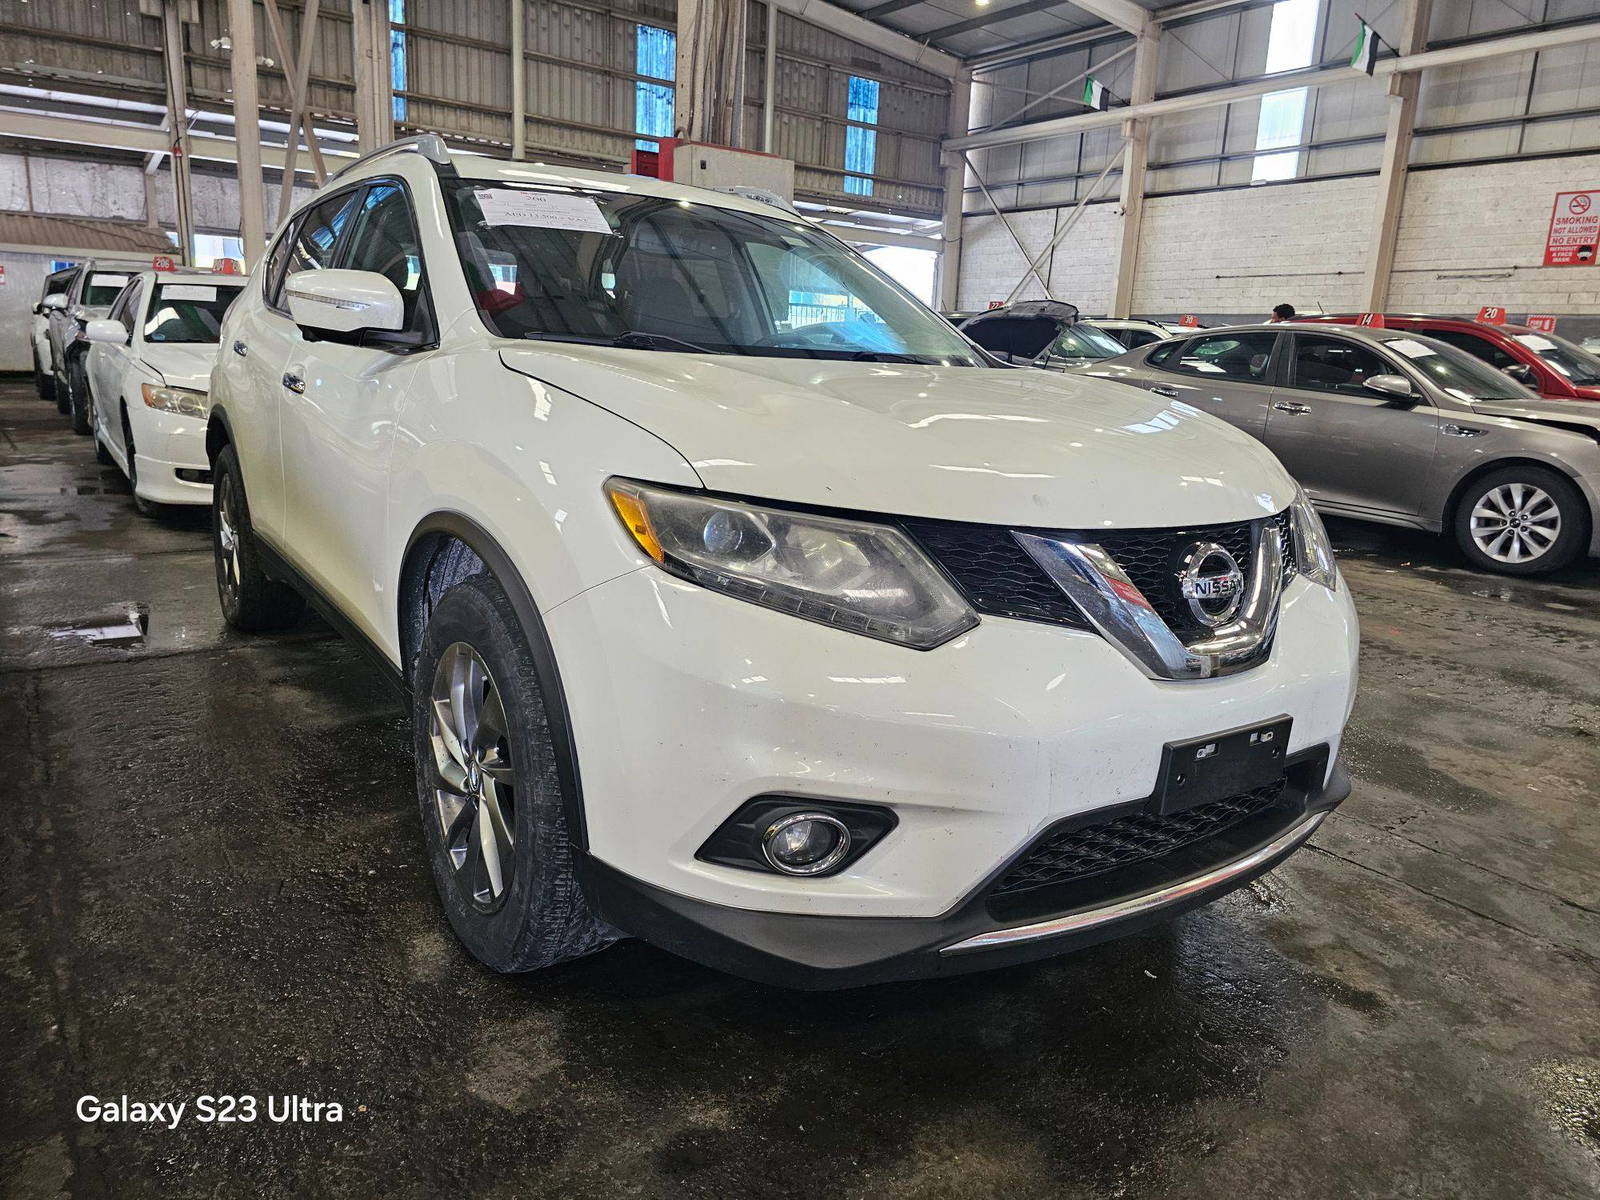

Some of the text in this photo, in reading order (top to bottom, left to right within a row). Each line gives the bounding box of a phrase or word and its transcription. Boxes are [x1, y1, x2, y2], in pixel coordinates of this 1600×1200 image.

[1556, 216, 1599, 225] SMOKING
[1568, 225, 1598, 234] ALLOWED
[1566, 236, 1595, 244] ENTRY
[1484, 307, 1498, 319] 20
[1361, 313, 1374, 326] 14
